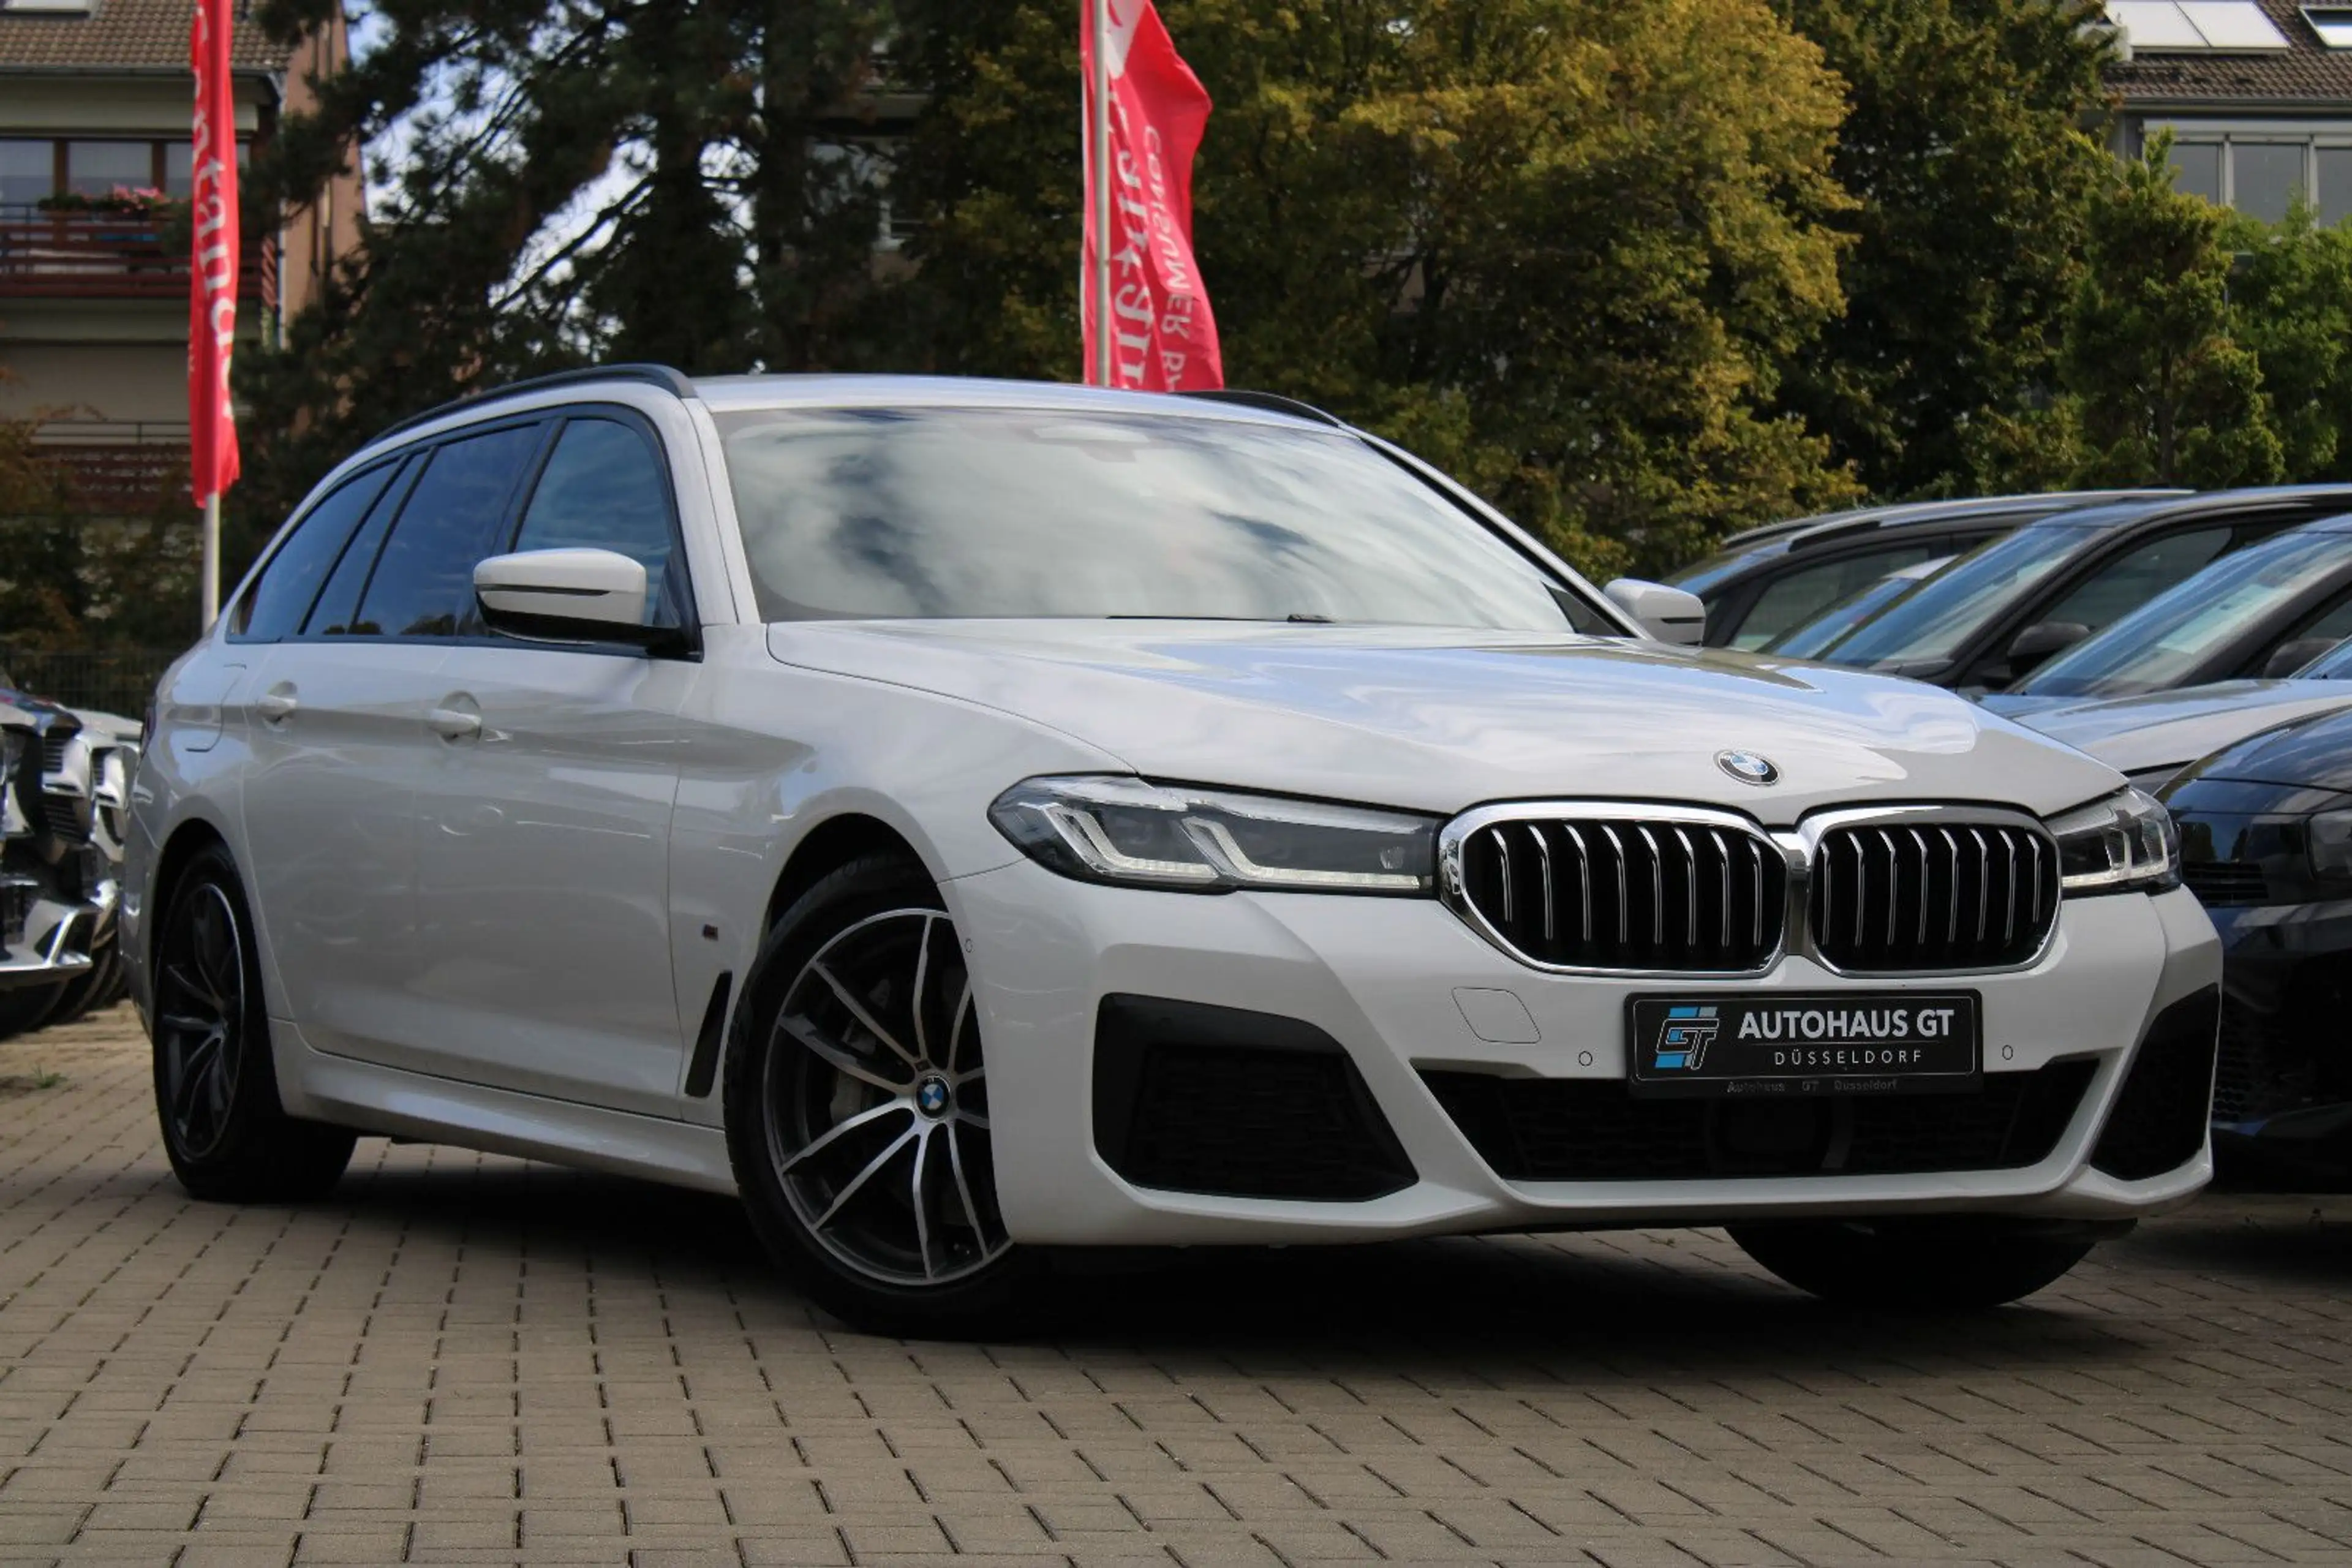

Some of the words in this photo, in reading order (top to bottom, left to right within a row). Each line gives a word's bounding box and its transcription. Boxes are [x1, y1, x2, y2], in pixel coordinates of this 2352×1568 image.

[1738, 1010, 1909, 1039] AUTOHAUS
[1917, 1009, 1954, 1036] GT
[1775, 1049, 1922, 1066] DÜSSELDORF
